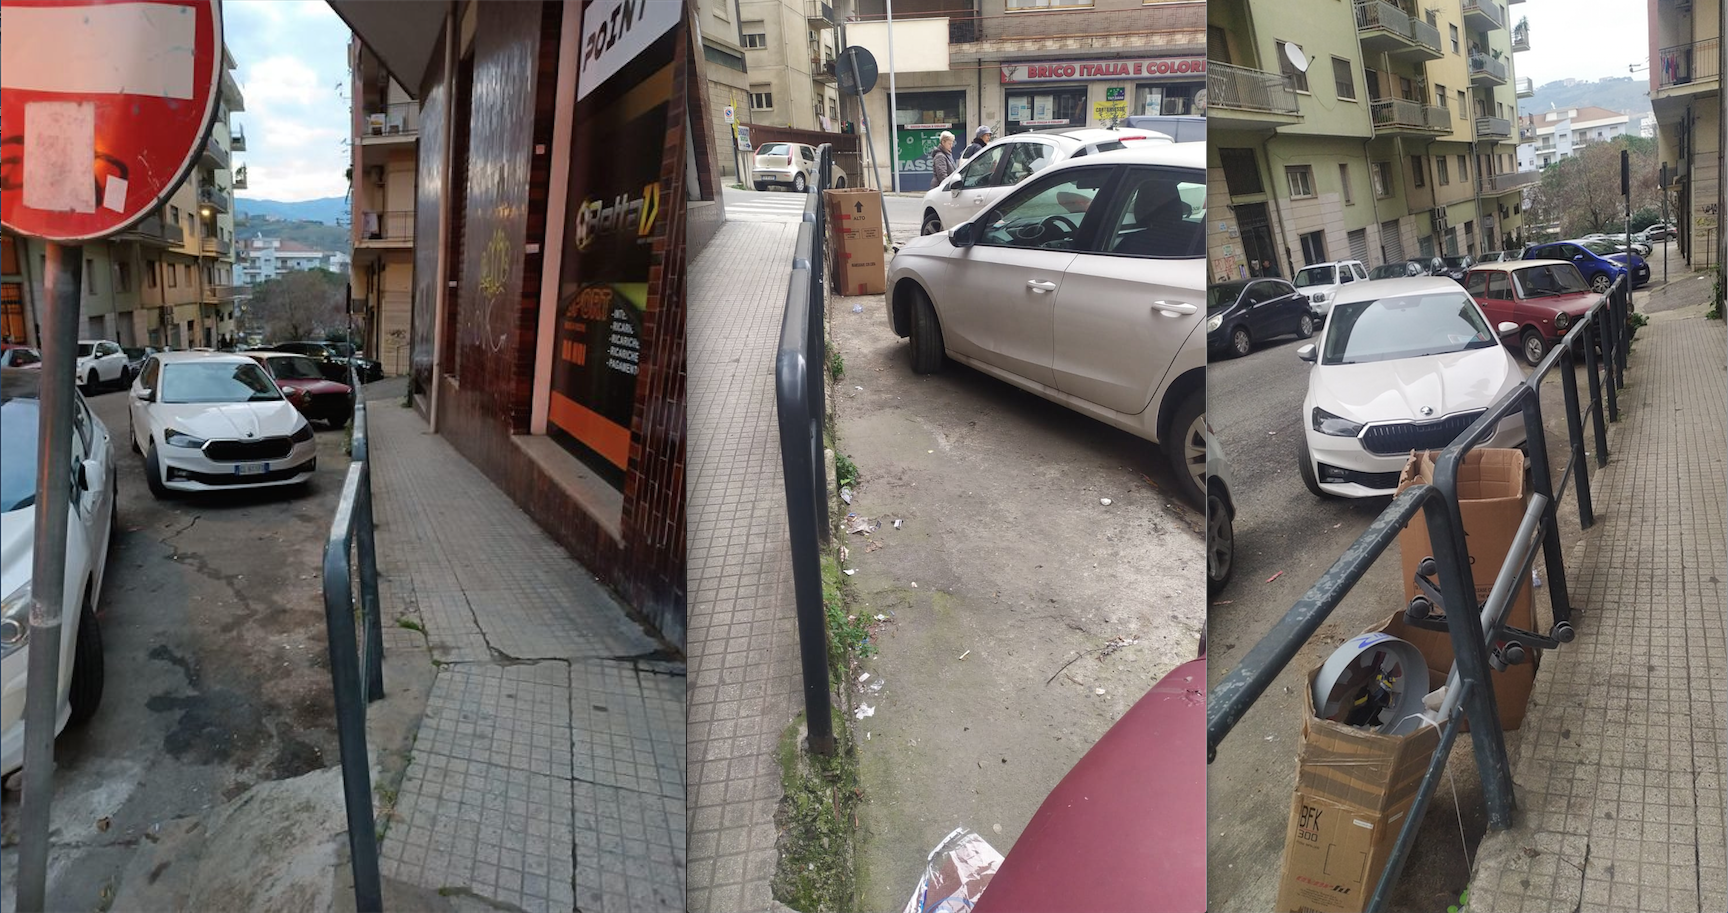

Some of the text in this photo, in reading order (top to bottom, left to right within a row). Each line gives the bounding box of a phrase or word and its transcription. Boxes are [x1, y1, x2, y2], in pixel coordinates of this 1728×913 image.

[1027, 60, 1206, 79] BRICO ITALIA E COLORI
[1299, 805, 1323, 831] BFK
[1297, 829, 1319, 842] 300
